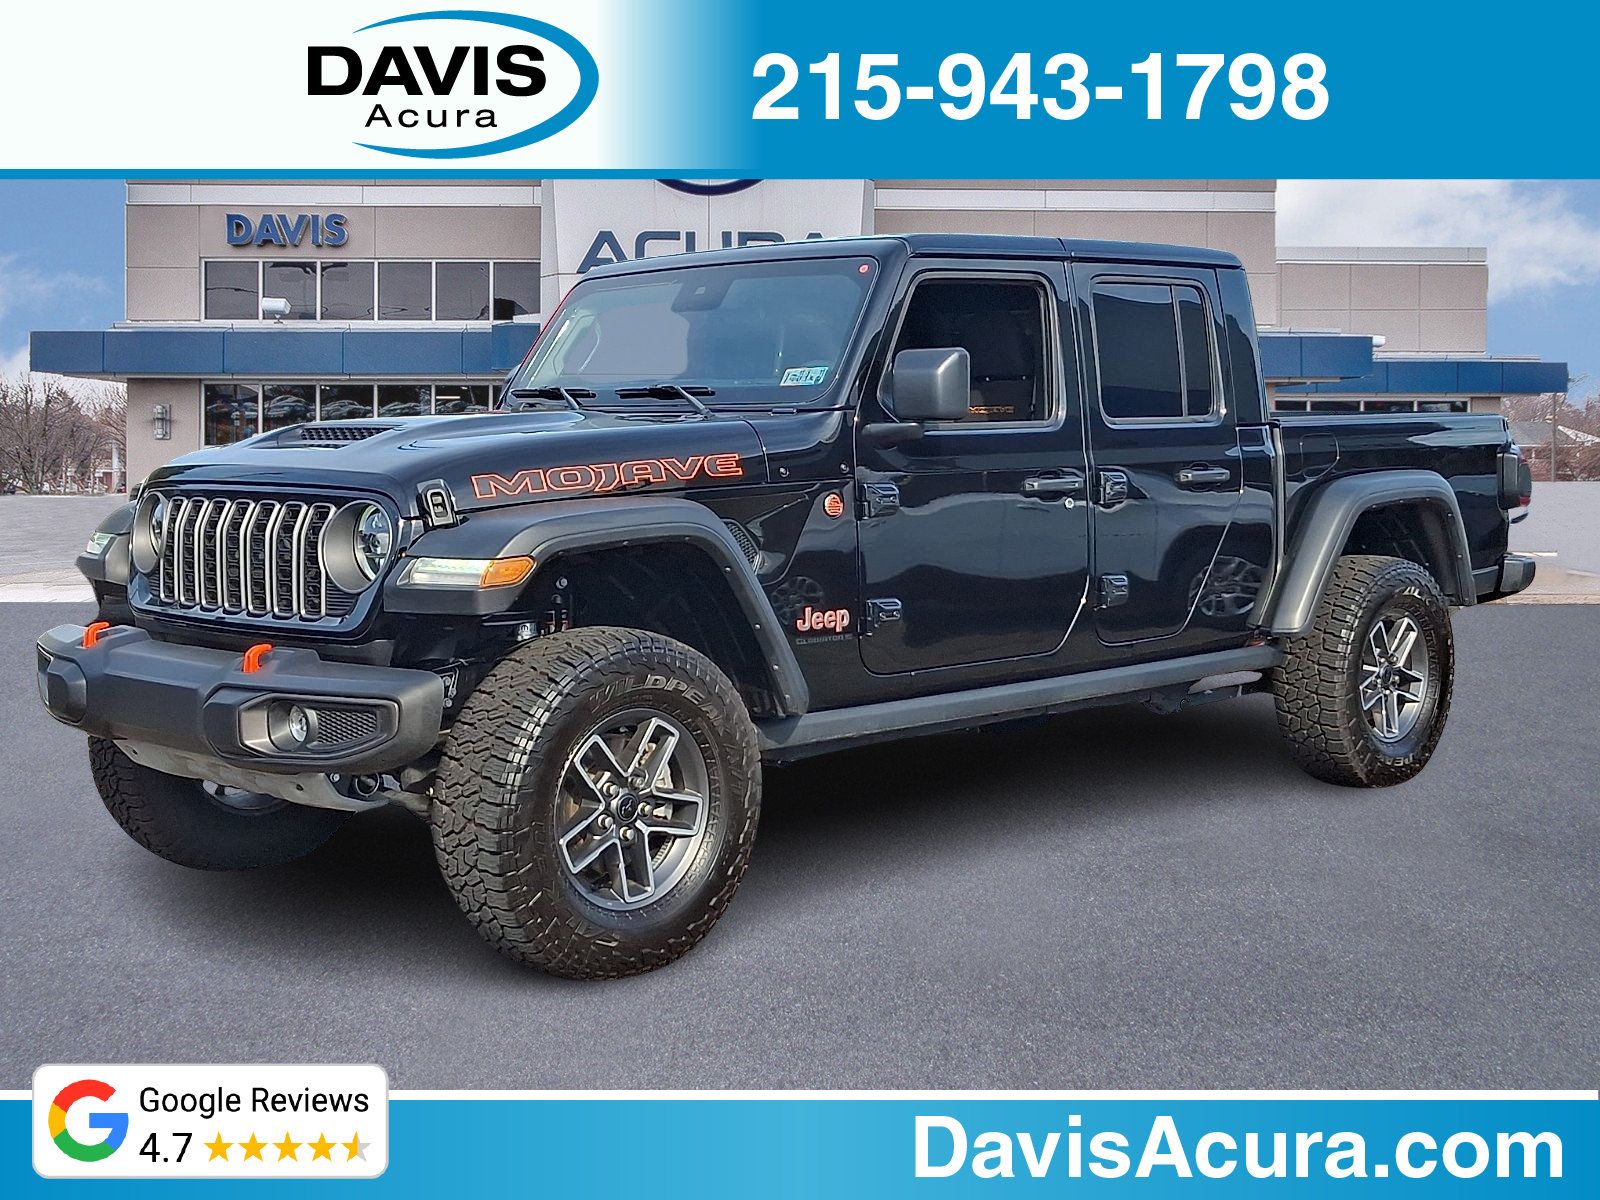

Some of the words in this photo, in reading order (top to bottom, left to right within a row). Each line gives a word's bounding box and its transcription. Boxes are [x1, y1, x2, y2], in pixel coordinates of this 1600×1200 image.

[226, 213, 349, 247] DAVIS
[471, 452, 743, 499] MOJAVE
[796, 606, 850, 632] Jeep
